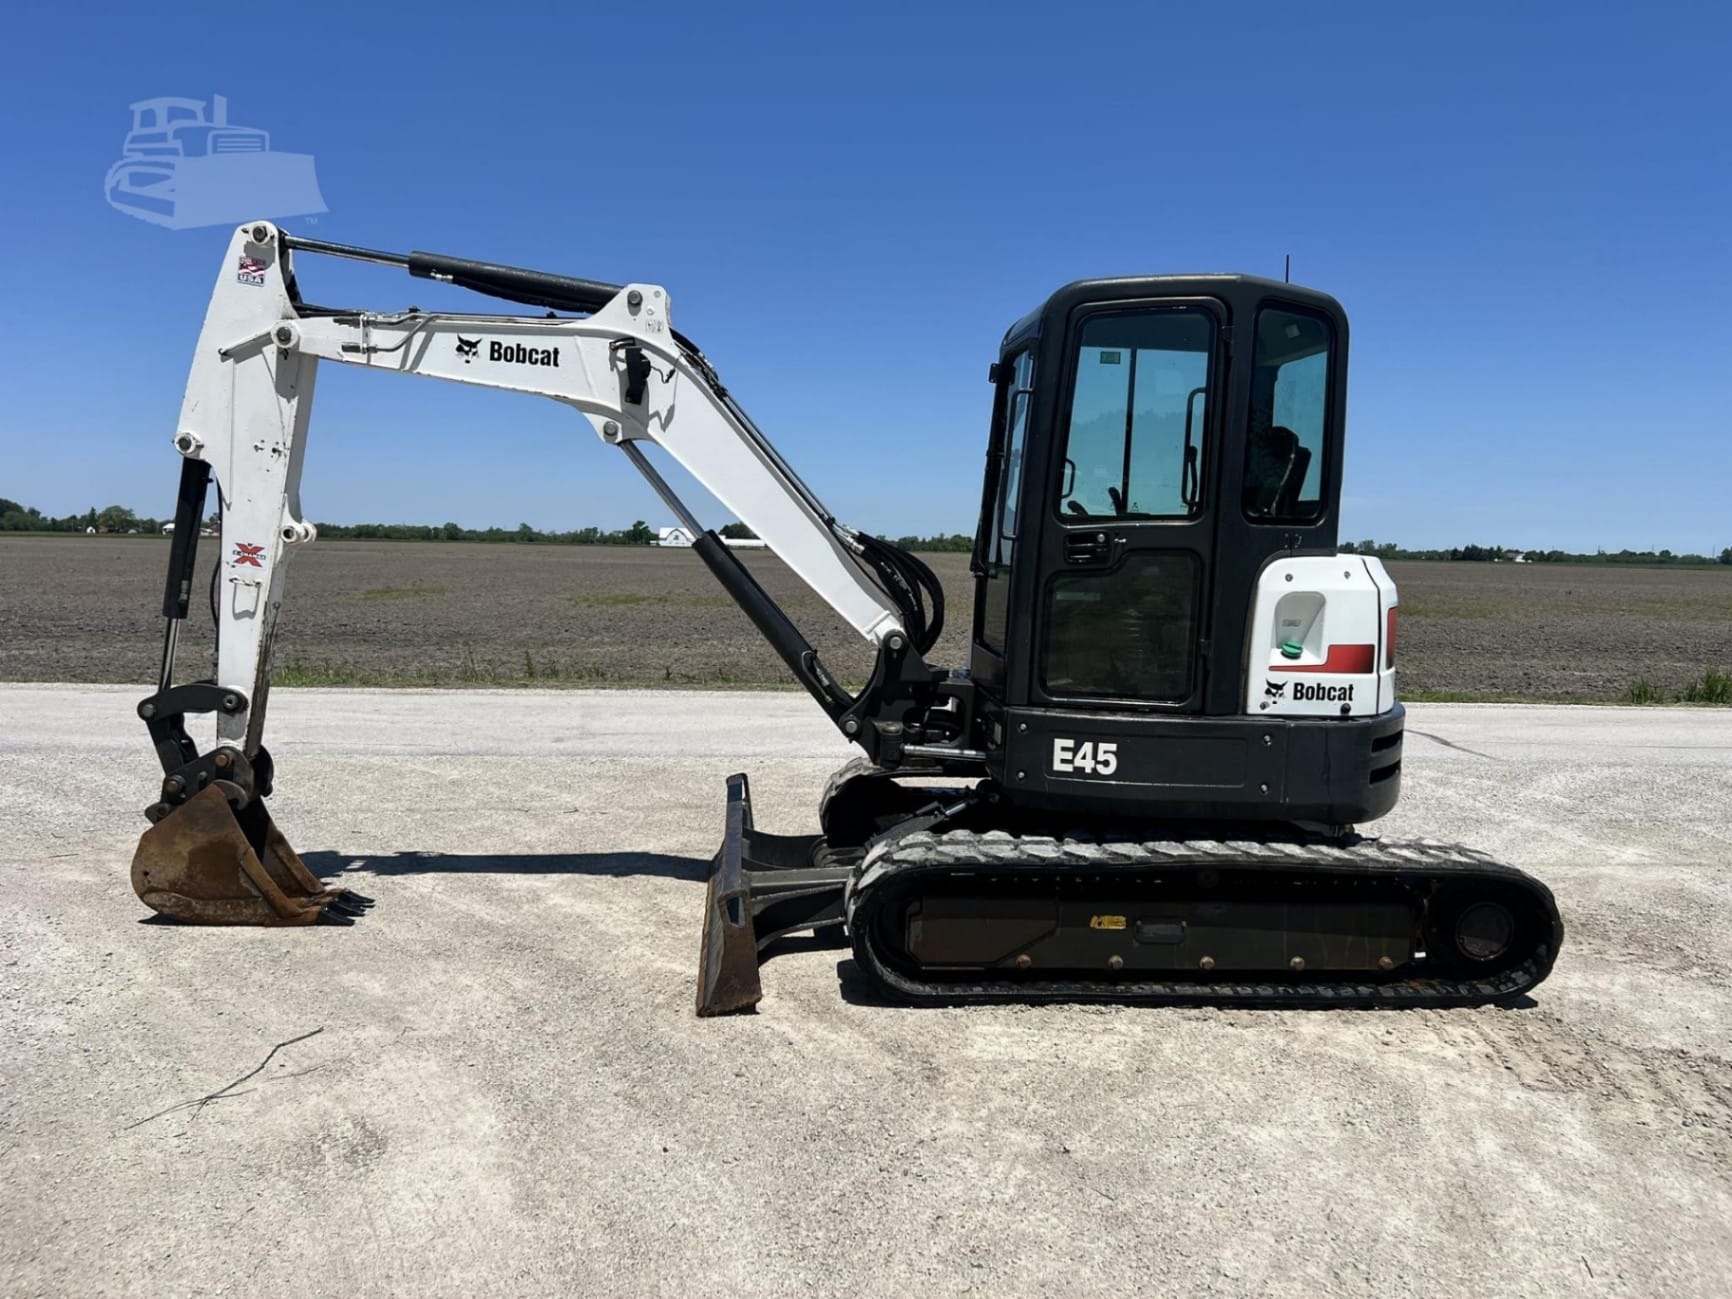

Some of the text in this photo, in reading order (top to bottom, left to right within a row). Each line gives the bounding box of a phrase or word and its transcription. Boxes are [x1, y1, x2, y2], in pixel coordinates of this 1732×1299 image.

[239, 274, 262, 284] USA
[489, 340, 560, 368] Bobcat
[1293, 682, 1354, 702] Bobcat
[1053, 738, 1118, 775] E45
